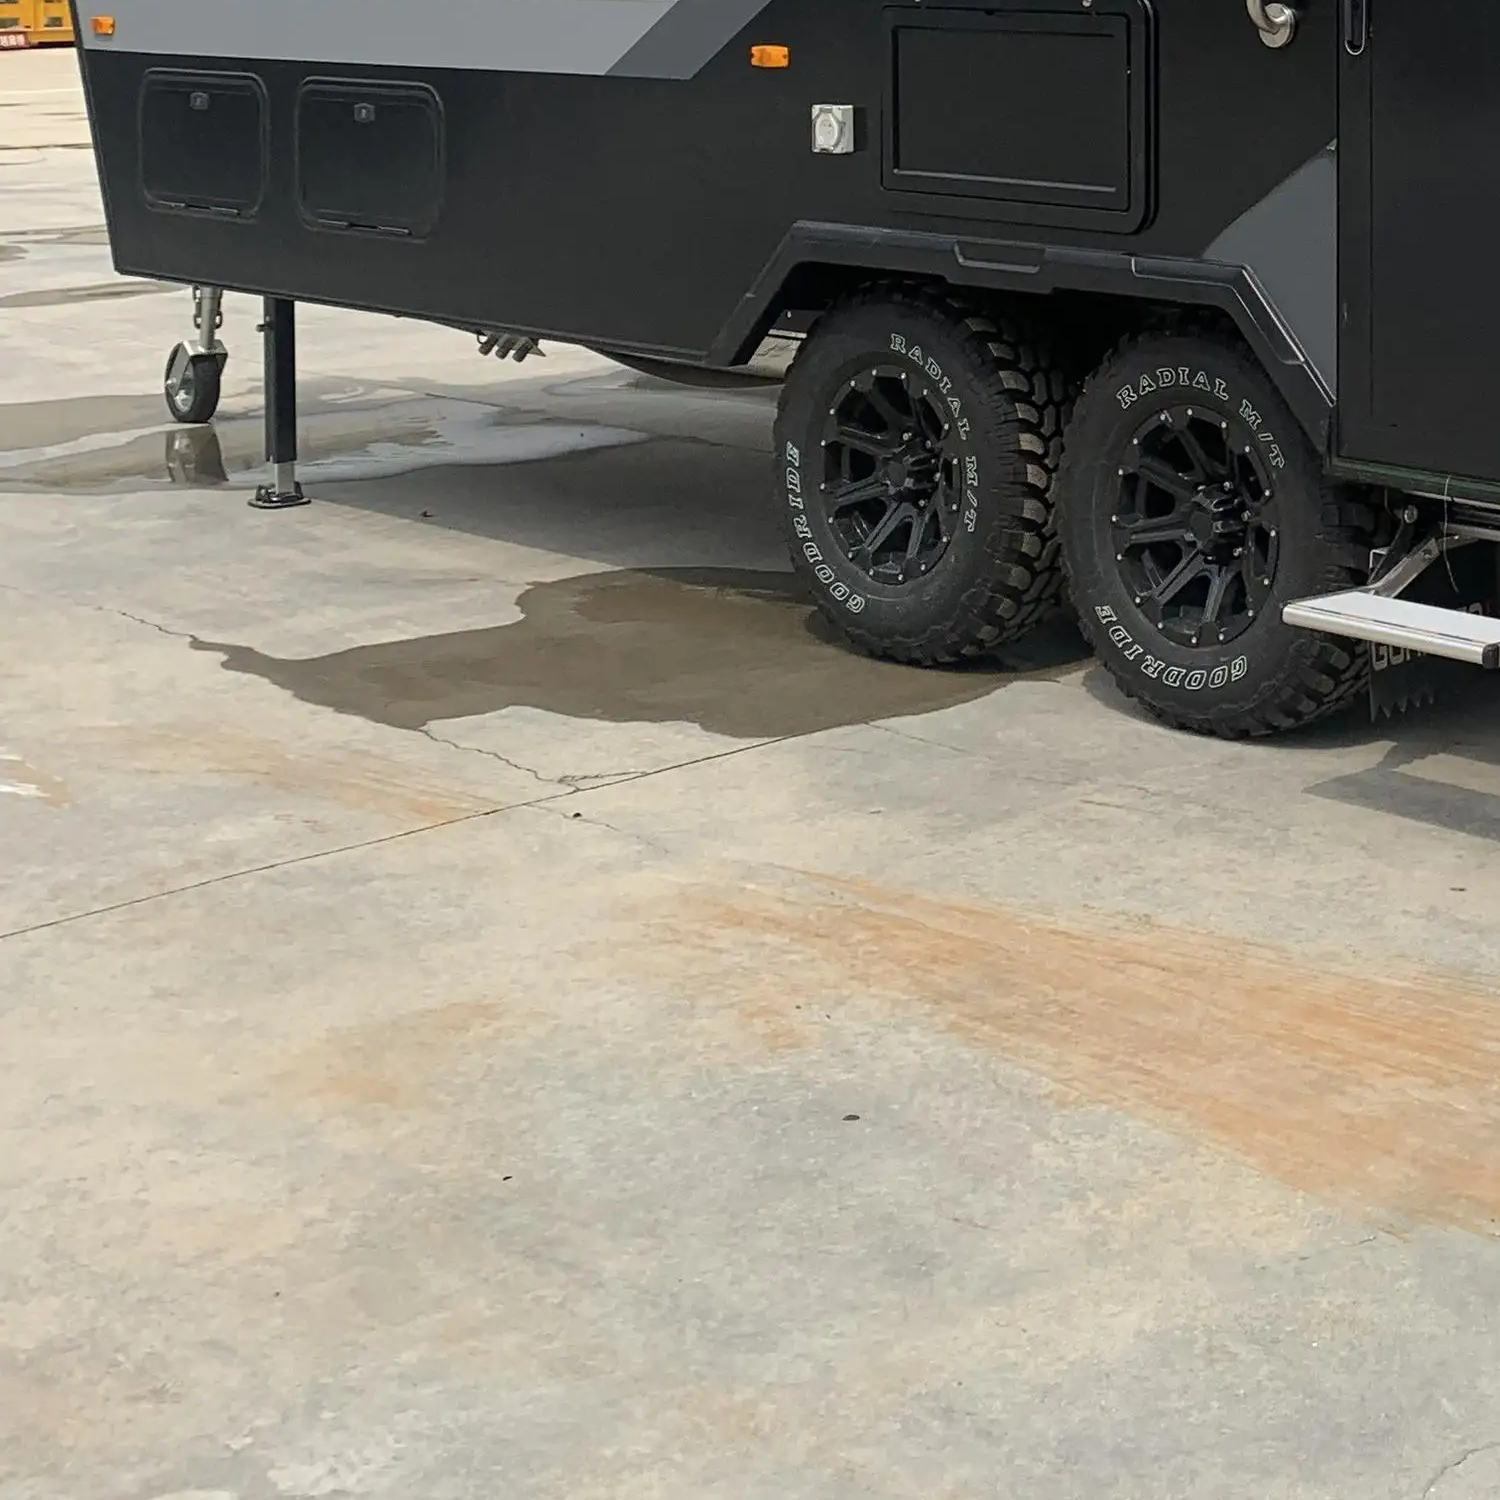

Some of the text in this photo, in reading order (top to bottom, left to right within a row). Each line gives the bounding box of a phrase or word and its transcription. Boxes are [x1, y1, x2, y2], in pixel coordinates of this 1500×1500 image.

[890, 333, 971, 441] RADIAL
[1115, 366, 1230, 410] RADIAL
[786, 441, 866, 614] GOODRIDE
[1095, 605, 1248, 690] GOODRIDE
